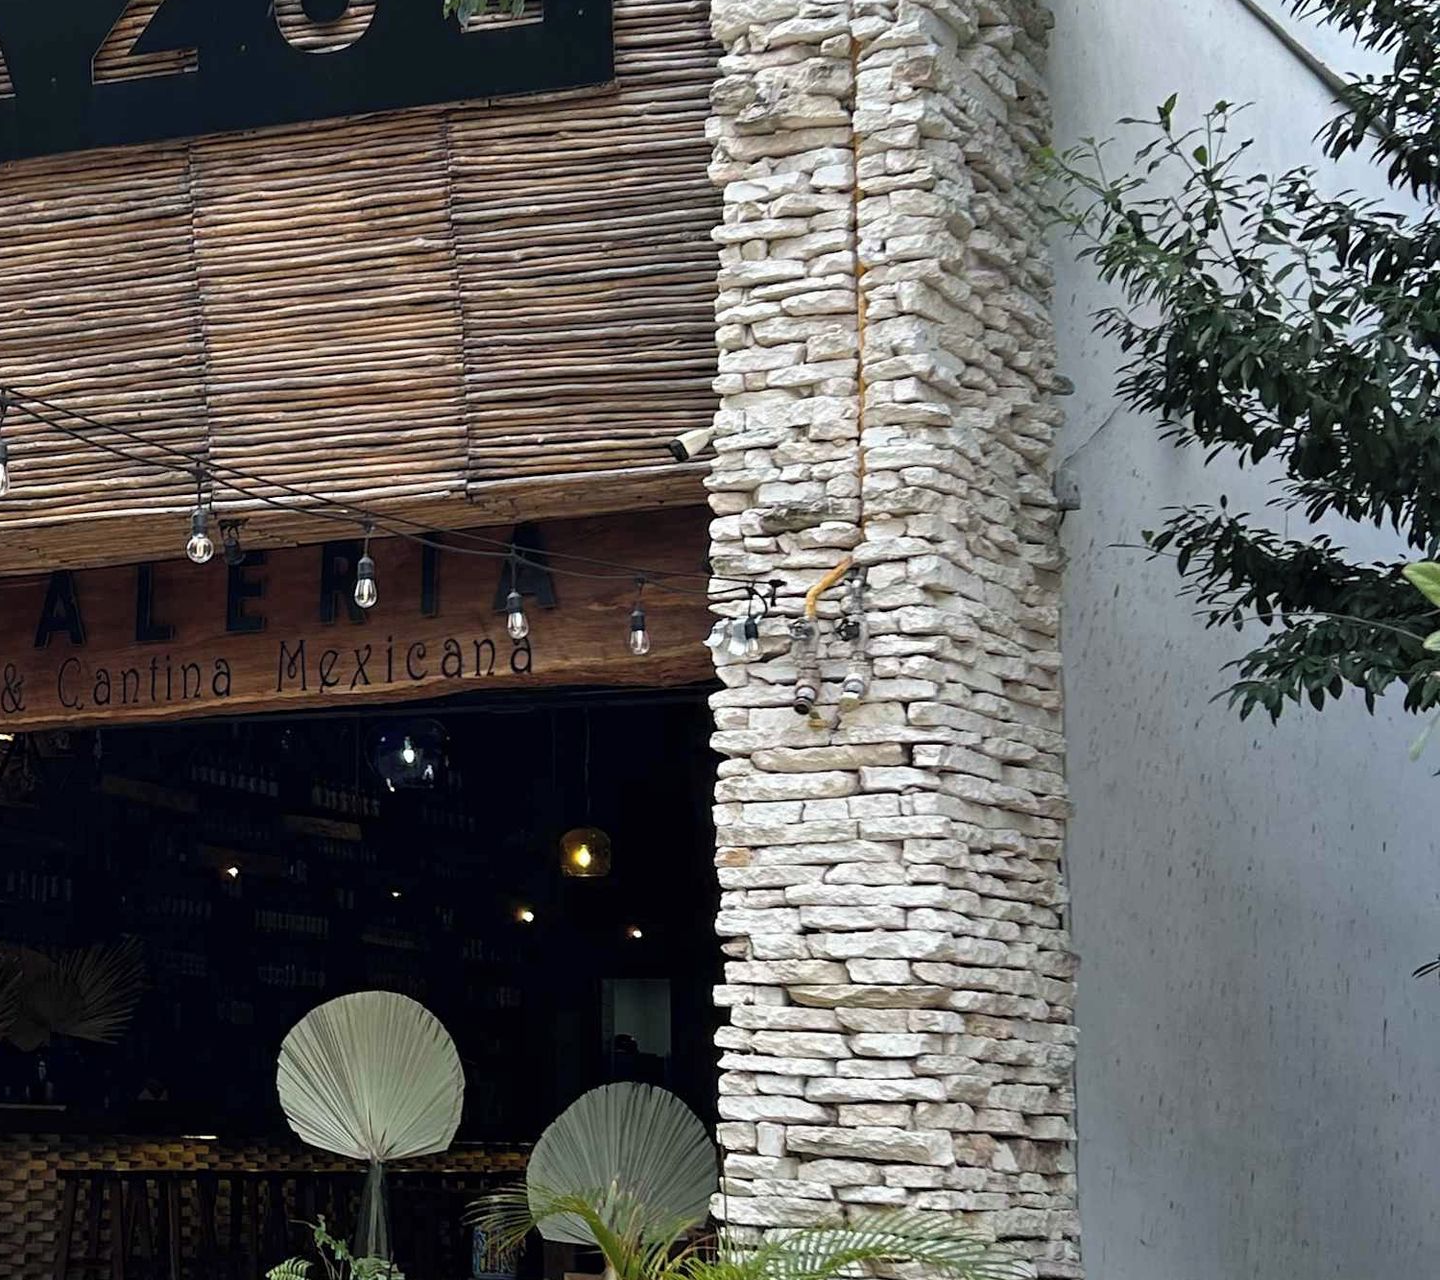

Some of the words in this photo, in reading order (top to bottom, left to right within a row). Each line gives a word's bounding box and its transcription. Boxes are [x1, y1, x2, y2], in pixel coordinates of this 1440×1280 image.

[0, 663, 25, 714] &
[58, 655, 231, 710] Cantina
[276, 635, 532, 693] Mexicana
